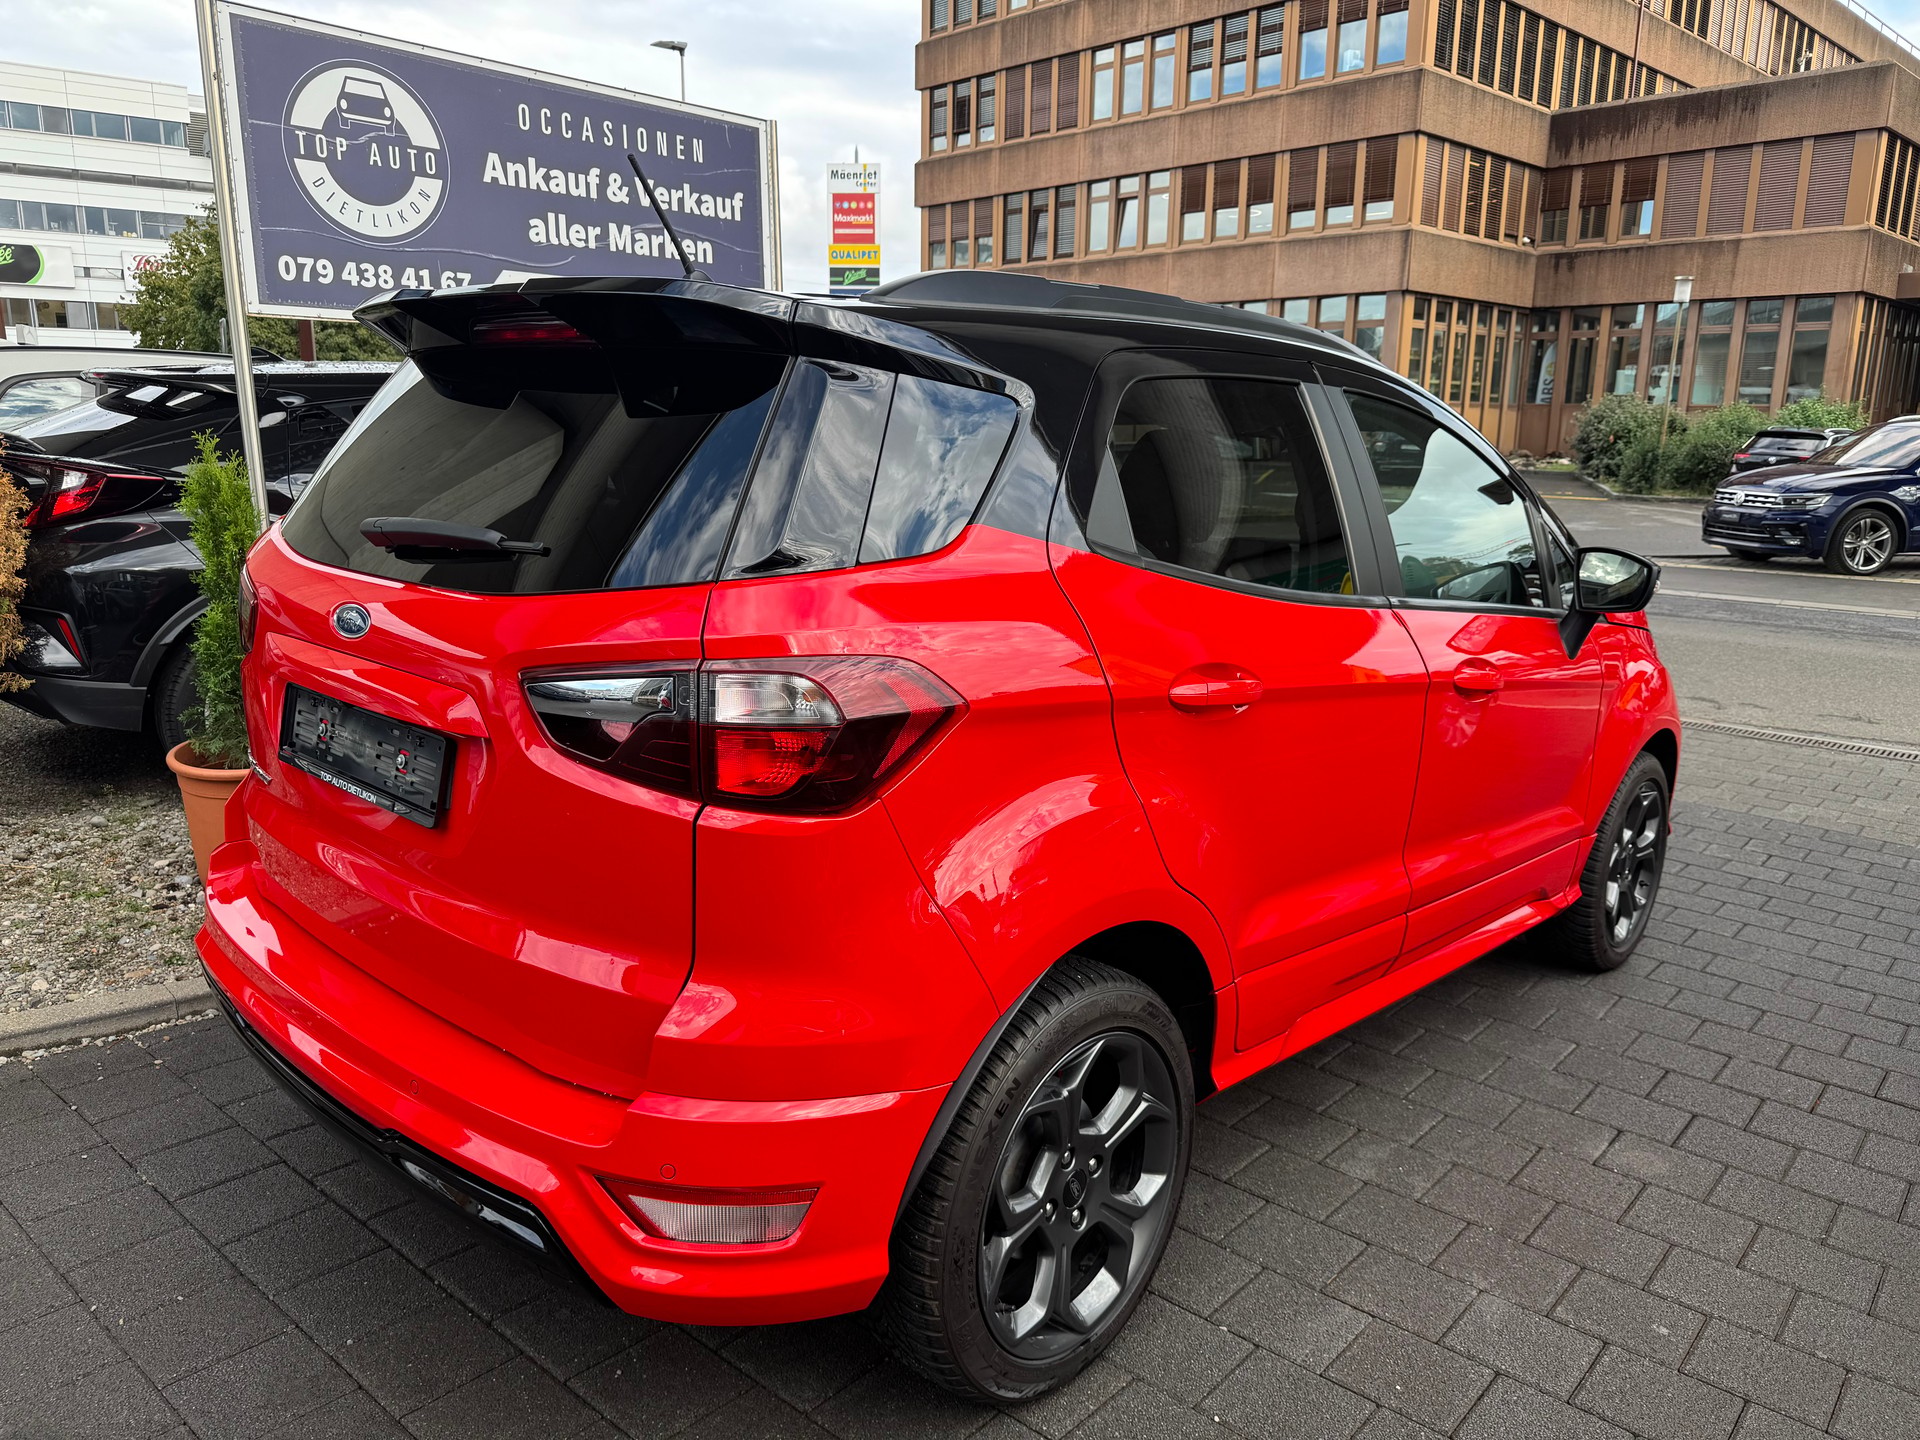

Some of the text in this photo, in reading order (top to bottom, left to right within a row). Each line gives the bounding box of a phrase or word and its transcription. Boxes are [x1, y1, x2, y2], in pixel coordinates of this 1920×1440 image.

[295, 130, 436, 175] TOP AUTO
[518, 103, 704, 163] OCCASIONEN
[312, 176, 431, 228] DIETLIKON
[483, 152, 744, 221] Ankauf & Verkauf
[528, 212, 713, 264] aller Marken
[831, 250, 879, 260] QUALIPET
[278, 254, 472, 289] 079 438 41 67
[320, 771, 377, 803] TOP AUTO DIETLIKON
